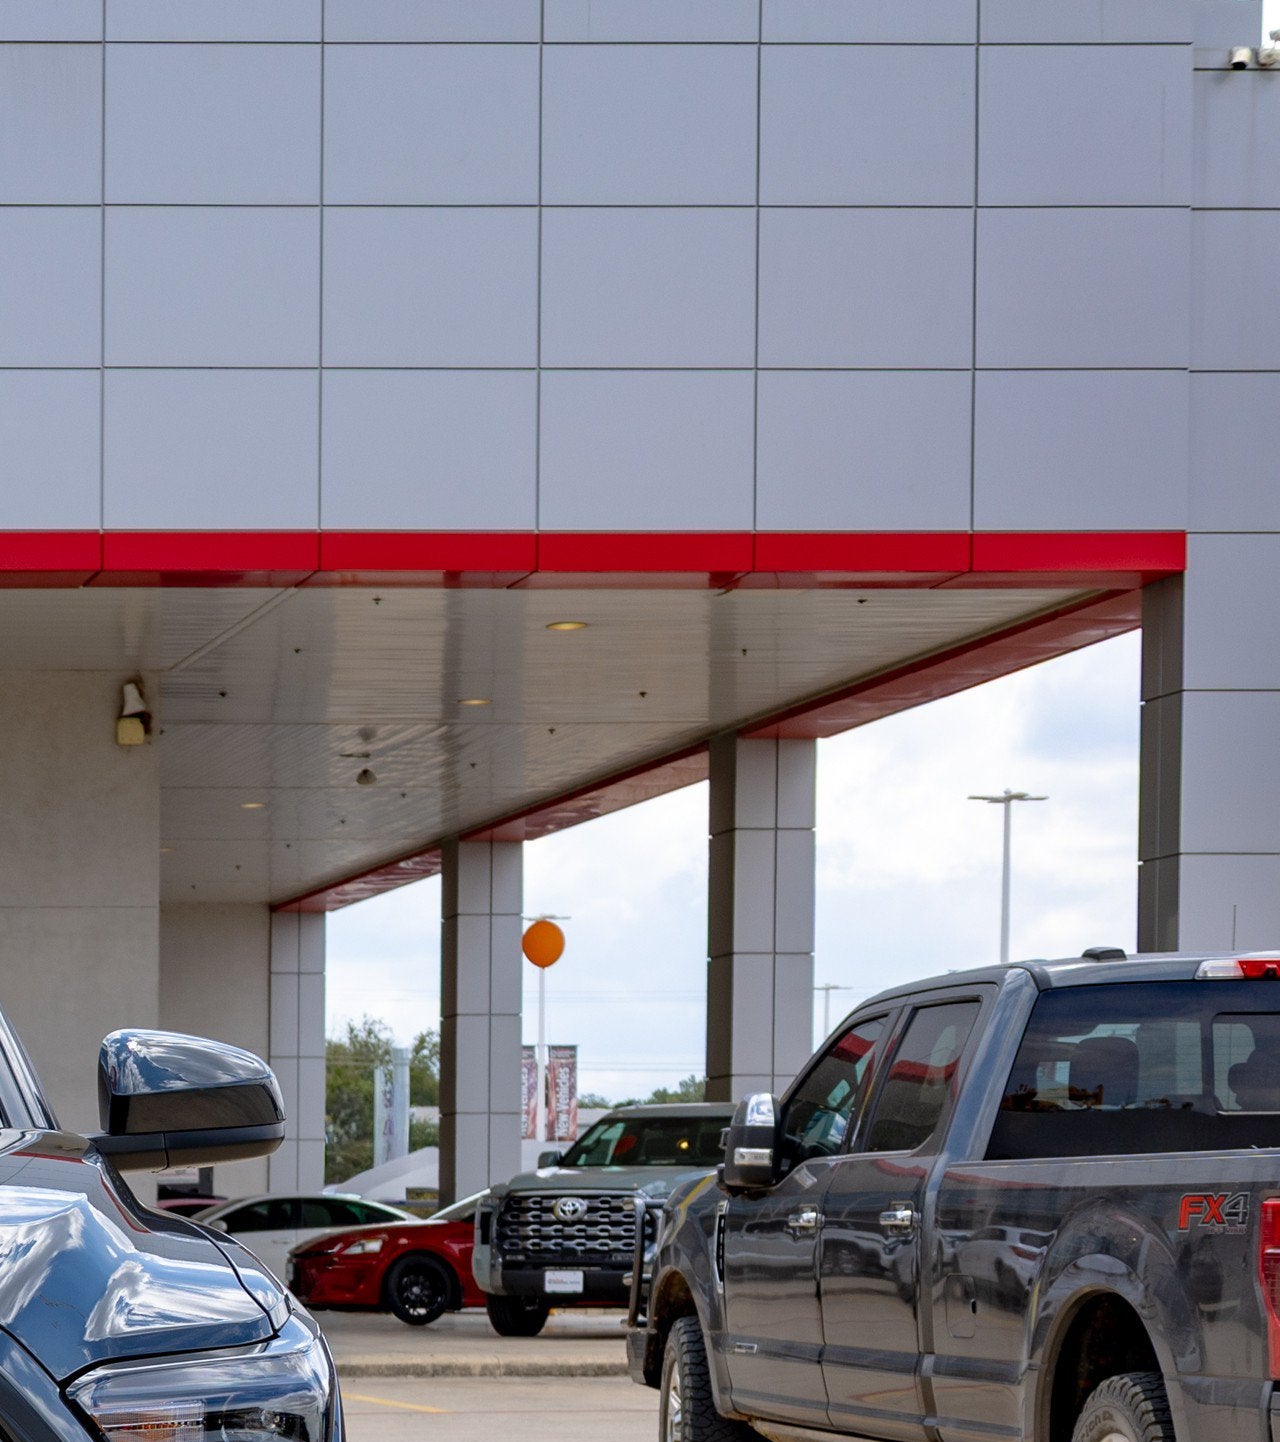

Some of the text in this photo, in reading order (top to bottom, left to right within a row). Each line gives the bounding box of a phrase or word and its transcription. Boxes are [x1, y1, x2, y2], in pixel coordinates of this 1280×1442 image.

[556, 1067, 570, 1112] Vehicles
[557, 1113, 570, 1136] New
[1177, 1191, 1251, 1233] FX4
